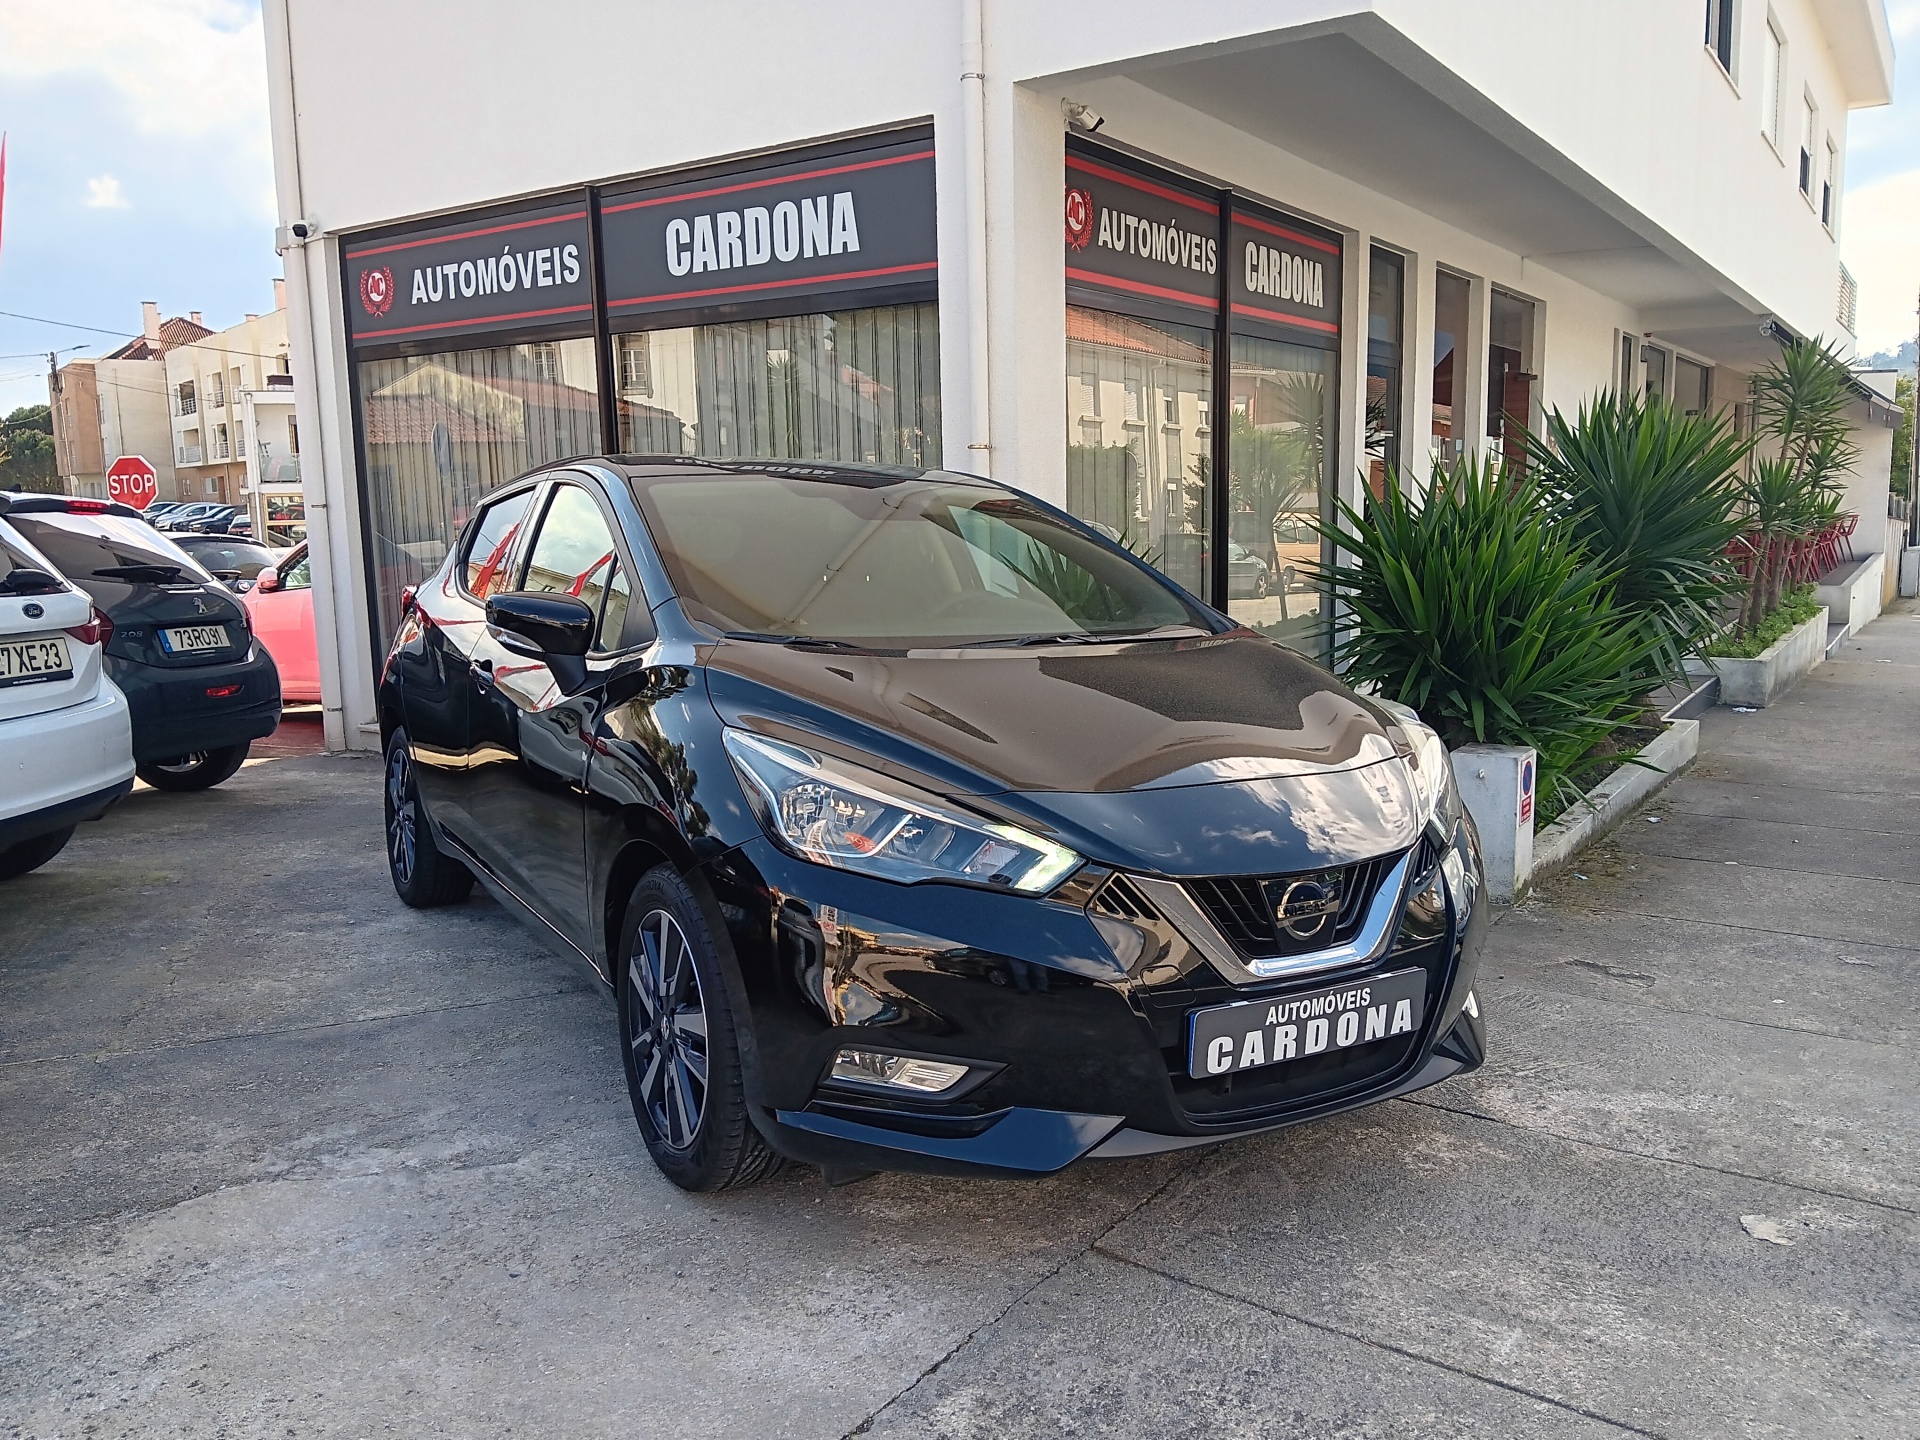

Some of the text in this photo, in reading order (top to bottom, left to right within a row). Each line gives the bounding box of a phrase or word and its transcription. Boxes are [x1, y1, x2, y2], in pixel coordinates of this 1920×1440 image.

[411, 191, 860, 305] AUTOMÓVEIS CARDONA
[1098, 207, 1324, 308] AUTOMÓVEIS CARDONA
[110, 473, 154, 495] STOP
[120, 630, 143, 638] 208
[174, 627, 223, 648] 73RO91
[1265, 988, 1371, 1026] AUTOMÓVEIS
[1206, 999, 1412, 1075] CARDONA
